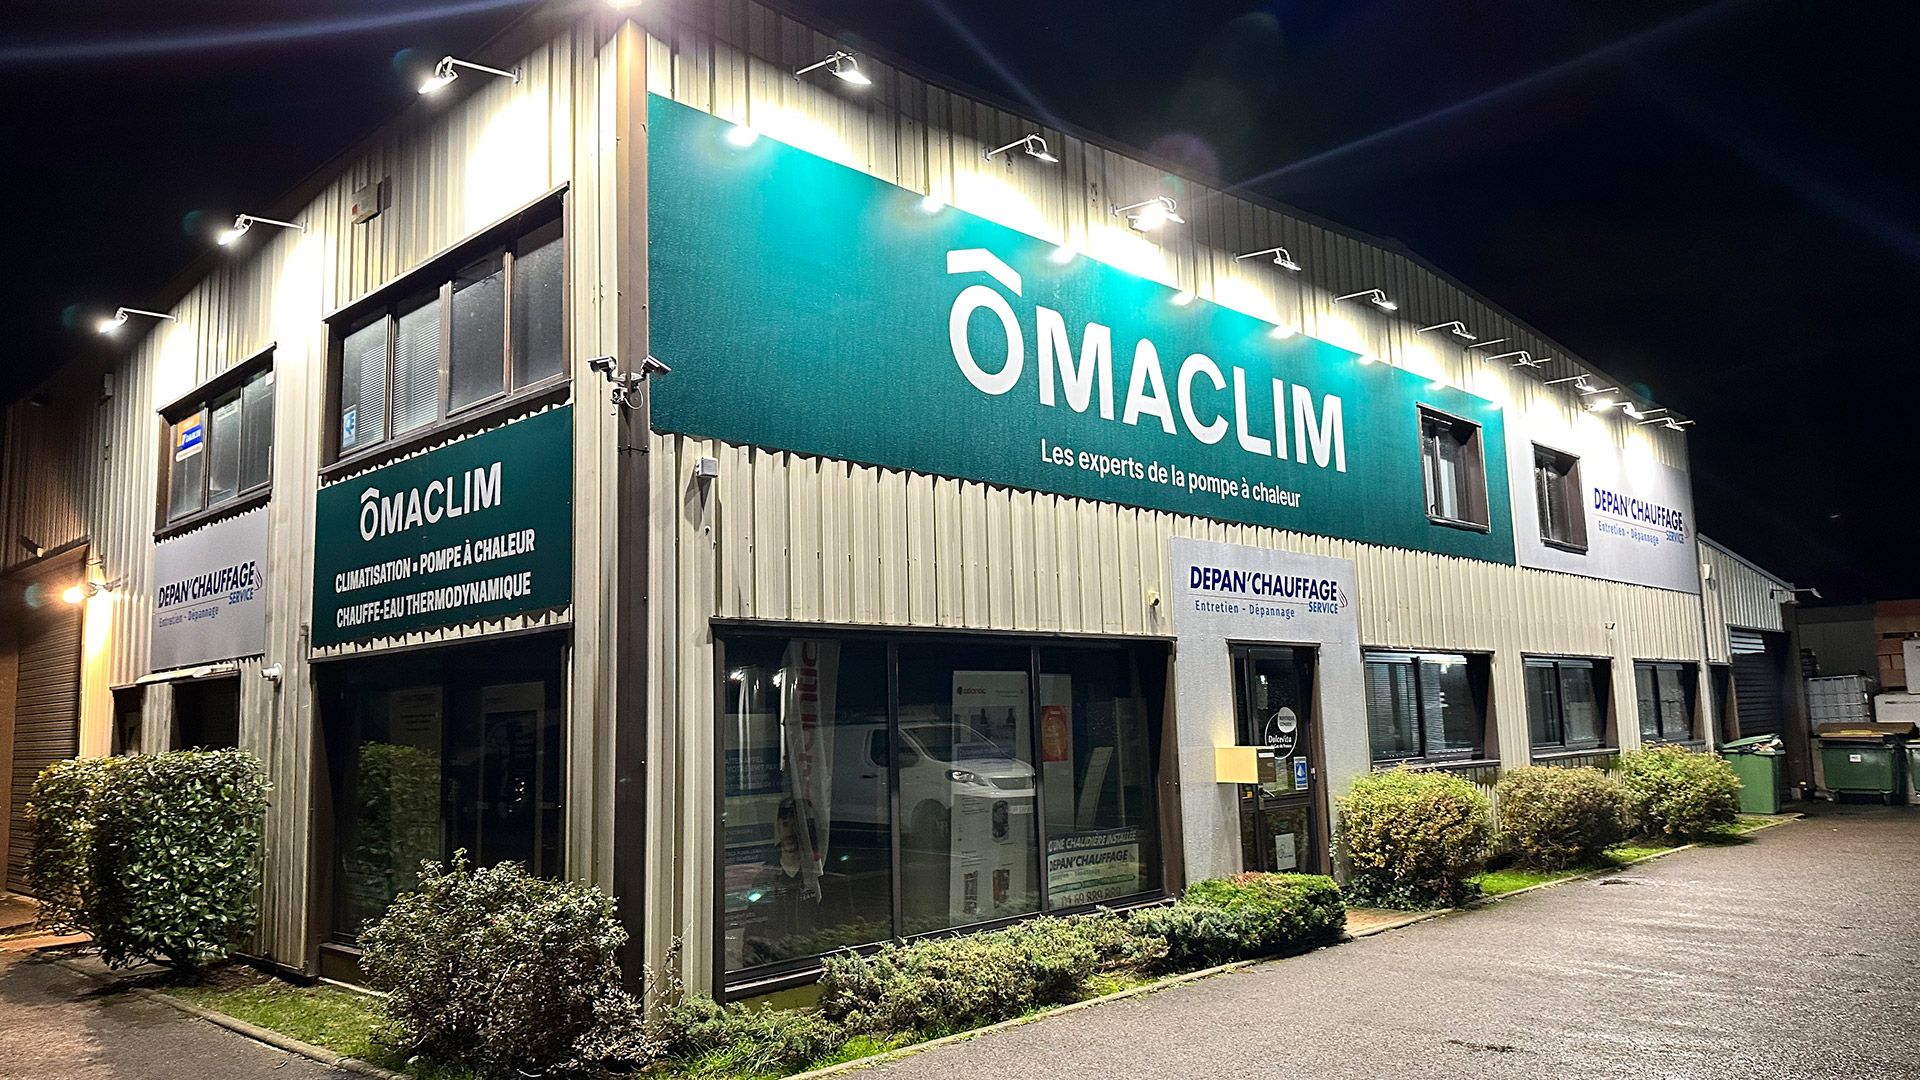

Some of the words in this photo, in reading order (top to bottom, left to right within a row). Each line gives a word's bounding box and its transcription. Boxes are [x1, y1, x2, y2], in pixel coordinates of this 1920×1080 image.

[947, 248, 1346, 472] ÔMACLIM
[1041, 438, 1074, 467] Les
[1078, 449, 1144, 479] experts
[1148, 461, 1168, 484] de
[1171, 464, 1185, 487] la
[1188, 472, 1238, 499] pompe
[1241, 477, 1250, 498] à
[1252, 482, 1301, 508] chaleur
[360, 461, 502, 541] ÔMACLIM
[1594, 488, 1683, 531] DEPAN'CHAUFFAGE
[1598, 520, 1626, 536] Entretien
[335, 557, 411, 593] CLIMATISATION
[420, 545, 462, 575] POMPE
[463, 539, 472, 566] À
[474, 528, 536, 563] CHALEUR
[158, 561, 255, 608] DEPAN'CHAUFFAGE
[229, 587, 254, 605] SERVICE
[336, 596, 405, 628] CHAUFFE-EAU
[405, 571, 532, 616] THERMODYNAMIQUE
[1190, 566, 1337, 601] DEPAN'CHAUFFAGE
[1195, 600, 1239, 614] Entretien
[1249, 603, 1295, 620] Dépannage
[1308, 601, 1339, 614] SERVICE
[1050, 849, 1129, 872] DEPAN'CHAUFFAGE
